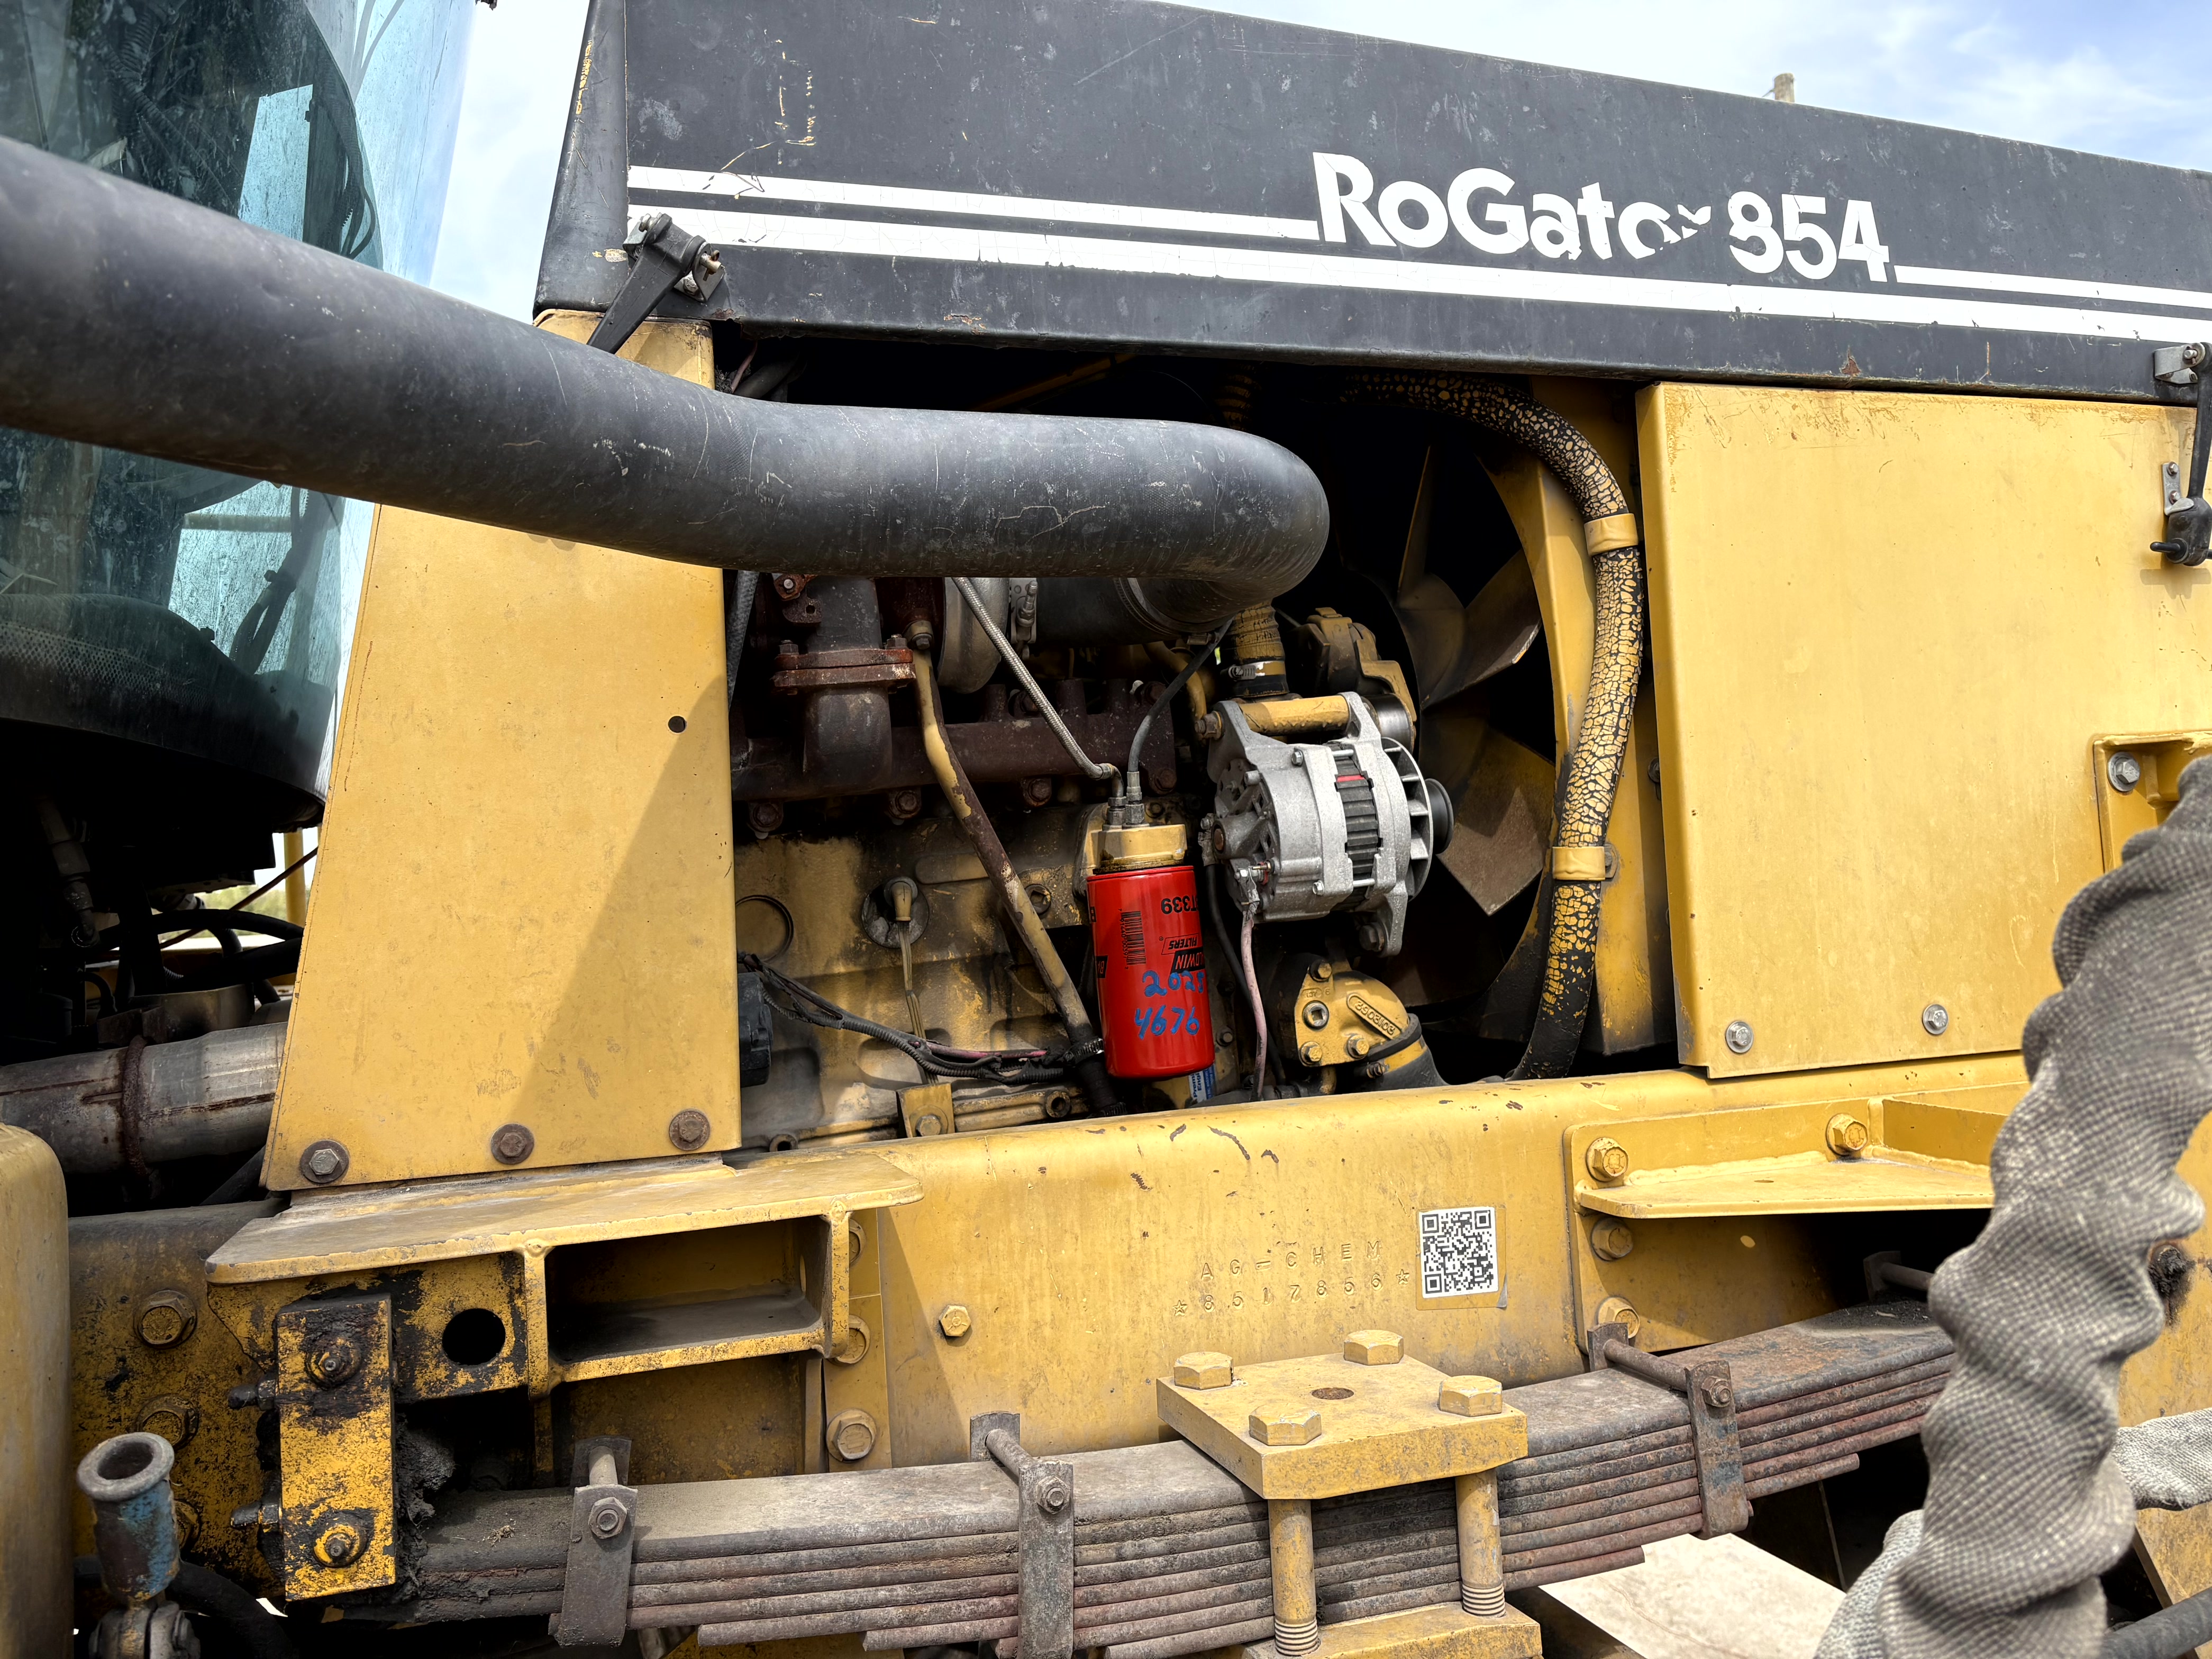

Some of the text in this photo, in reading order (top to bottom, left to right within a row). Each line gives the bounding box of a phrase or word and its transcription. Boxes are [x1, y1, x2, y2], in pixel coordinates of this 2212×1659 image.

[1727, 191, 1890, 282] 854
[1161, 895, 1199, 915] T339
[1168, 936, 1198, 951] FILTERS
[1135, 1005, 1200, 1040] 4676
[1200, 1241, 1381, 1281] AG-CHEM
